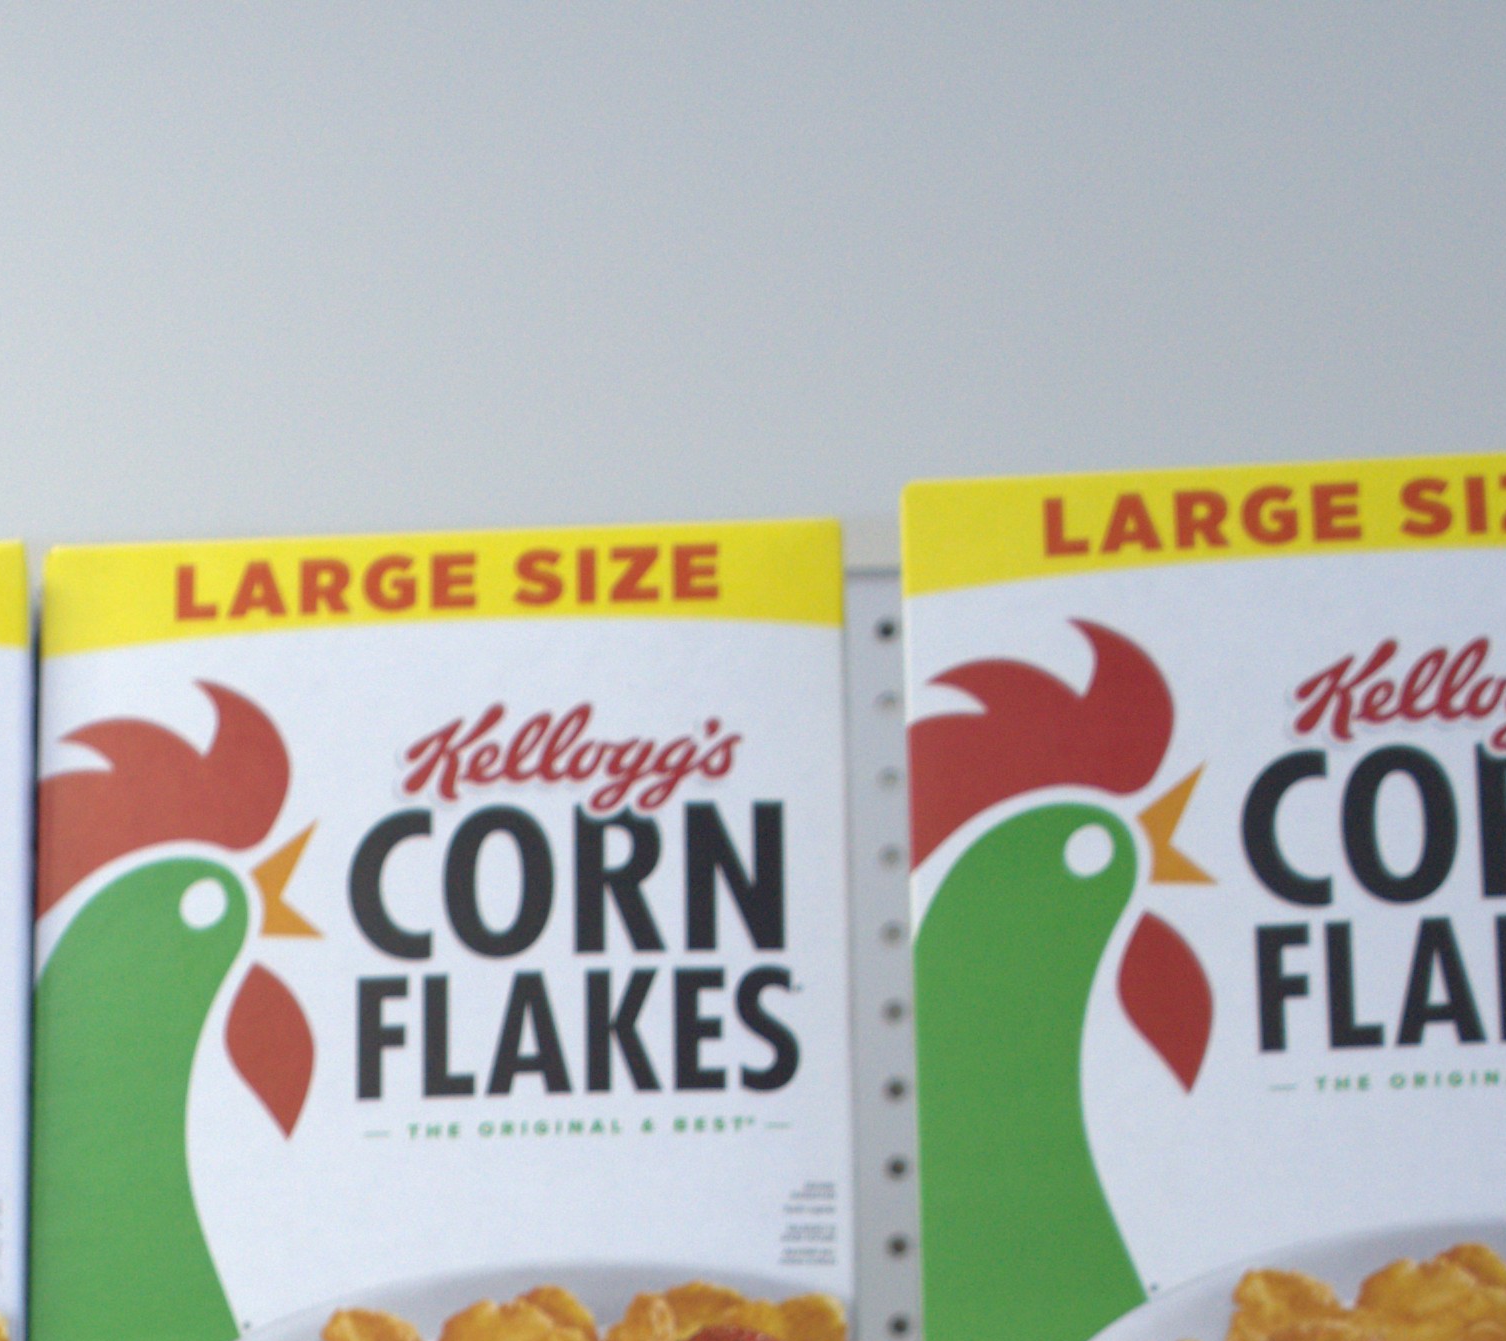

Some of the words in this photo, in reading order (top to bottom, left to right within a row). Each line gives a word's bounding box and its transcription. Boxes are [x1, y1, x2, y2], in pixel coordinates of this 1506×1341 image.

[1043, 482, 1362, 558] LARGE
[174, 552, 478, 622] LARGE
[514, 543, 722, 606] SIZE
[402, 702, 742, 811] Kellogg's
[347, 800, 788, 961] CORN
[355, 965, 802, 1101] FLAKES
[1317, 1074, 1371, 1093] THE
